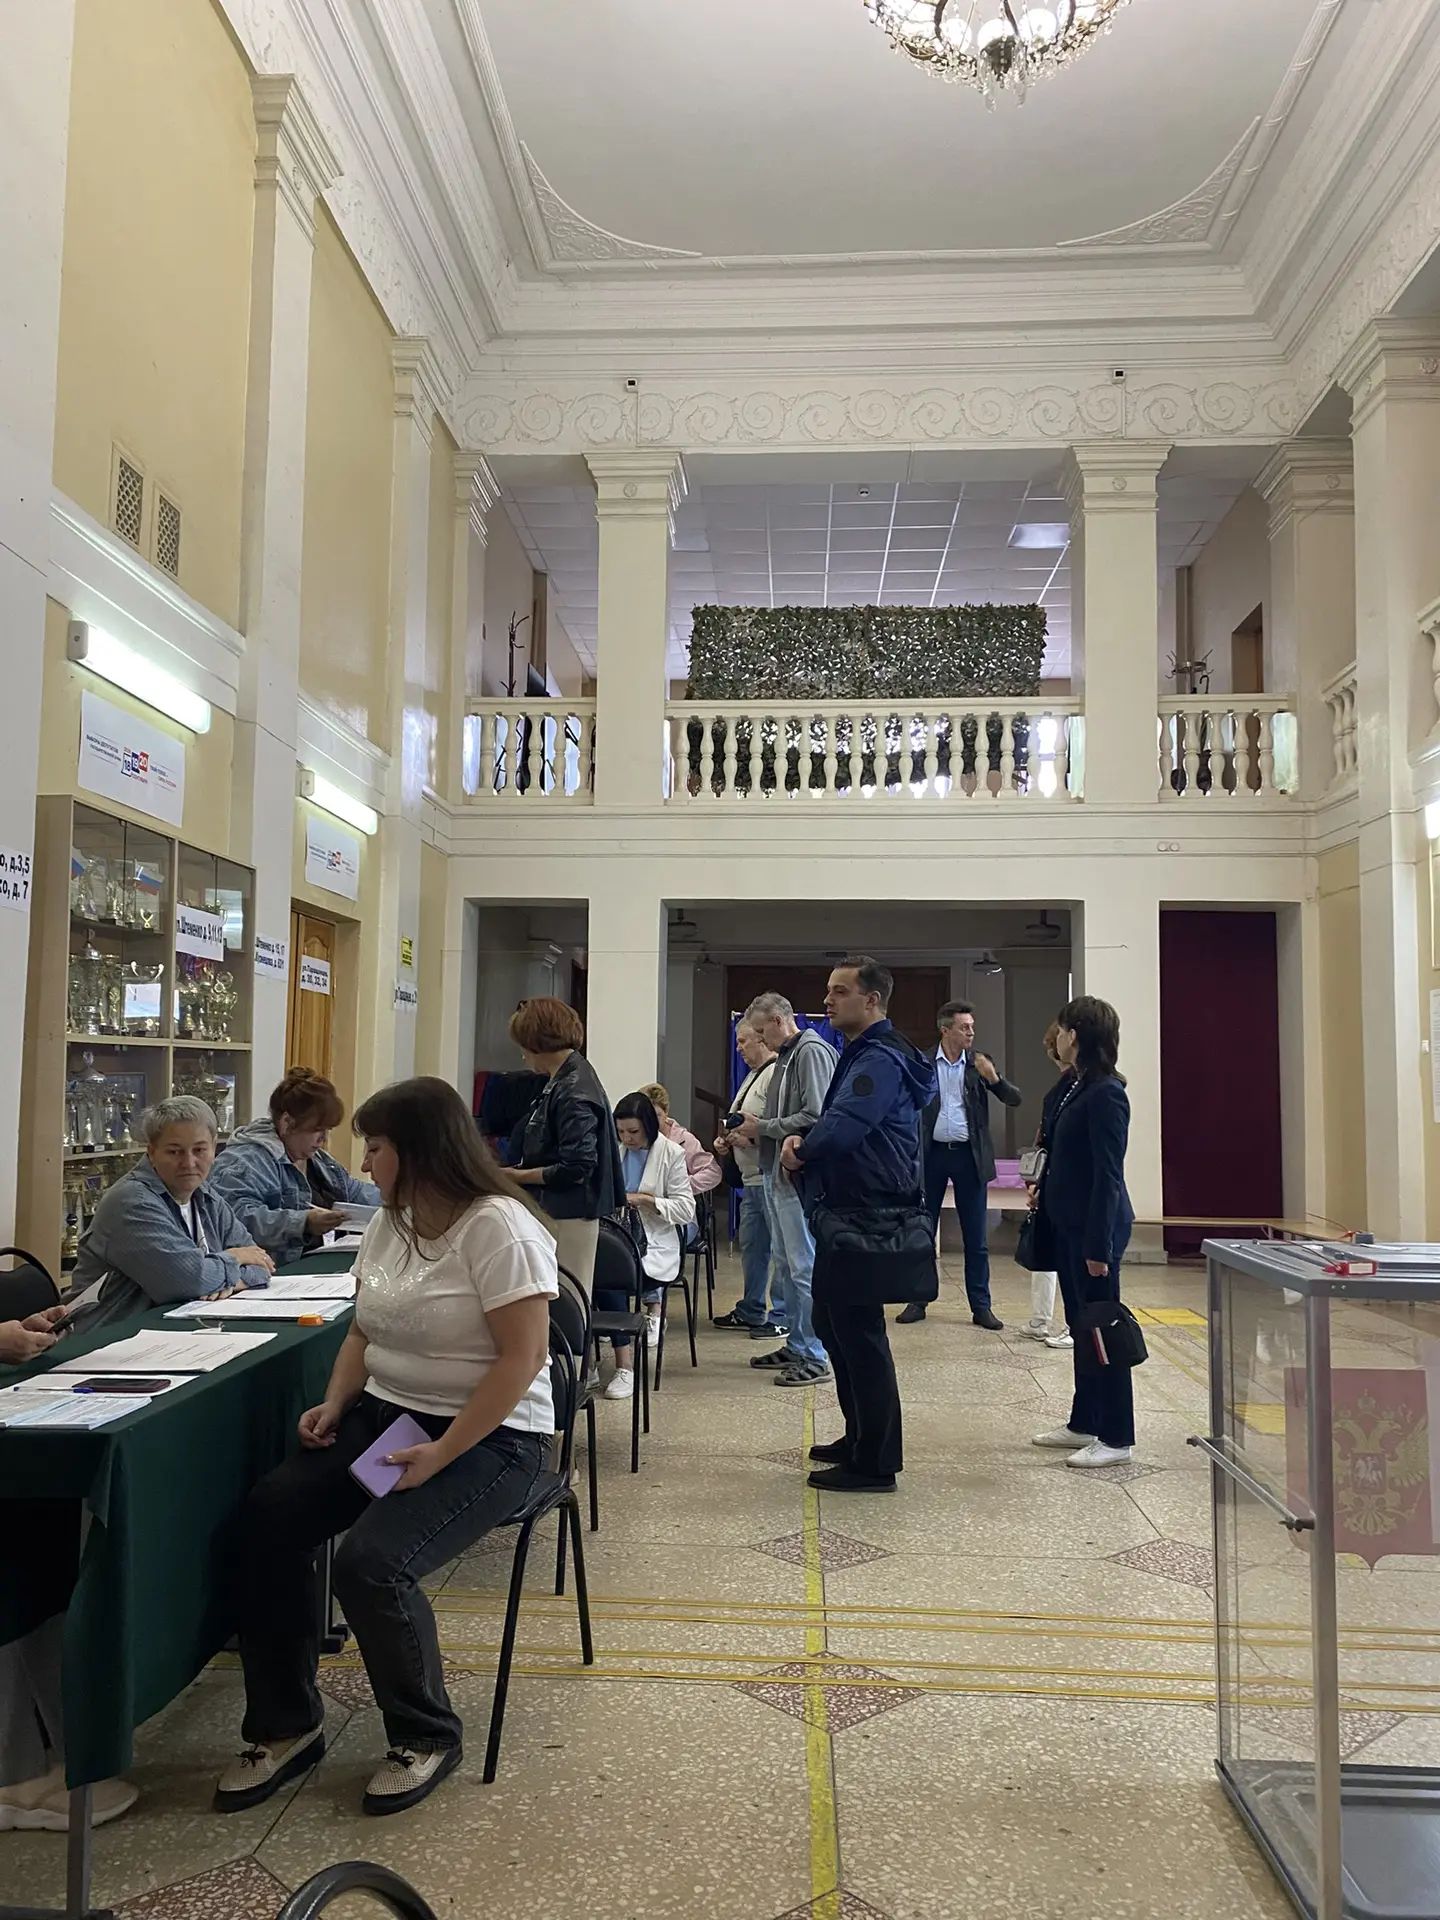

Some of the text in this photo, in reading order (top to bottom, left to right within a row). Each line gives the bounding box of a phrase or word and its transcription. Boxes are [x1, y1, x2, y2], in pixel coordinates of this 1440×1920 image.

[124, 758, 131, 772] 18
[139, 754, 148, 768] 20
[12, 882, 21, 901] д.
[23, 880, 29, 899] 7
